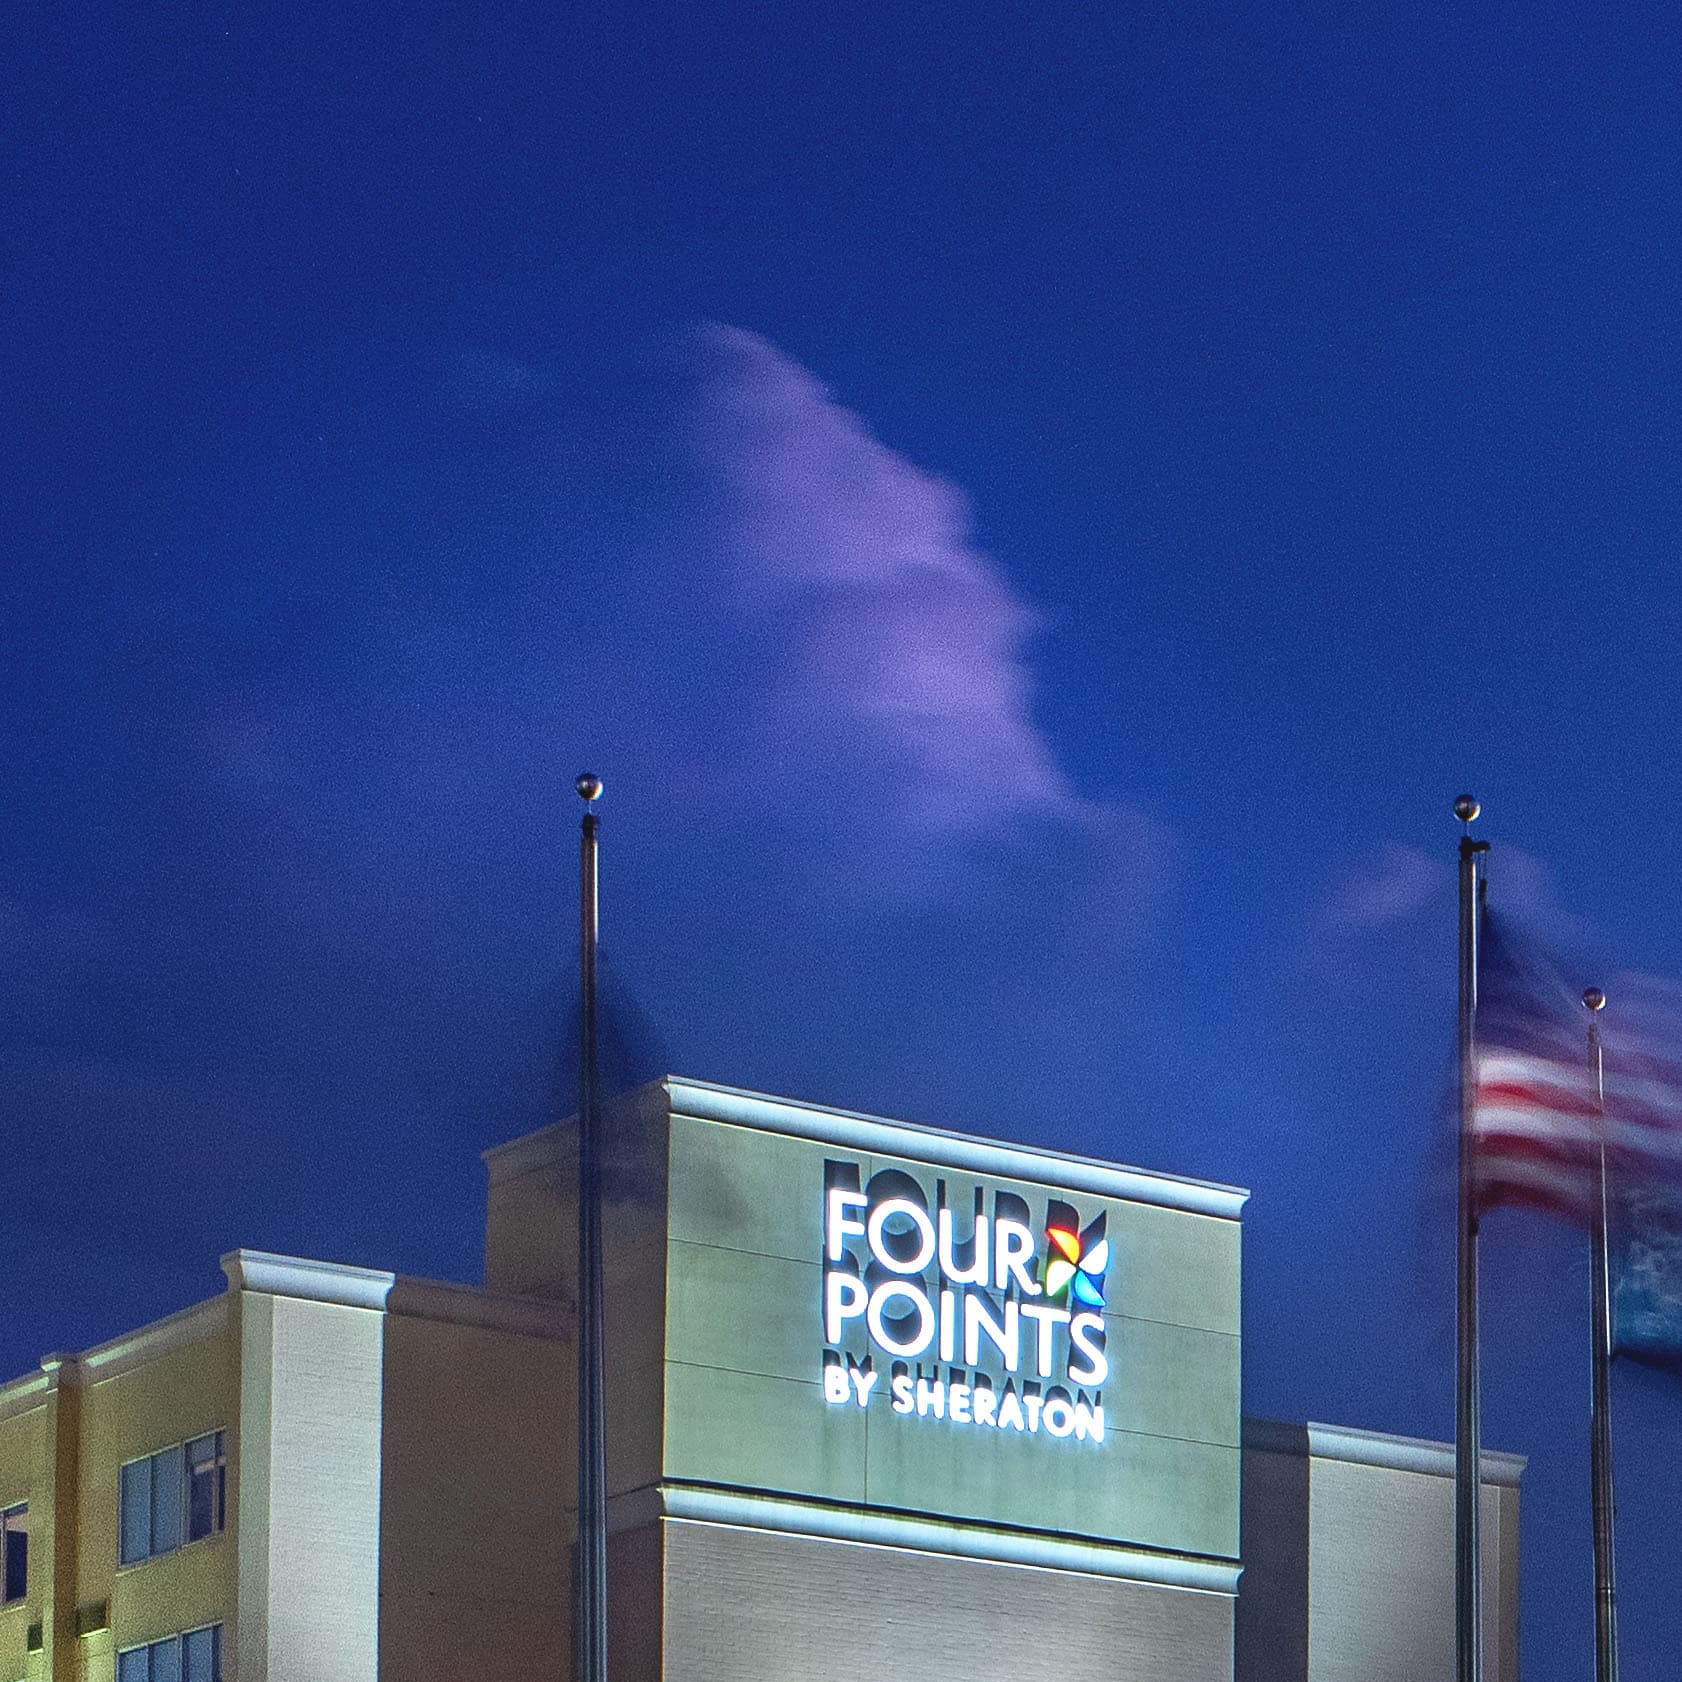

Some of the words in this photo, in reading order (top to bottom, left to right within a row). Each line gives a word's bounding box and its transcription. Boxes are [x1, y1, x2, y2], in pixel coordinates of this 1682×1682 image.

[827, 1187, 1042, 1297] FOUR
[826, 1271, 1109, 1387] POINTS
[824, 1365, 878, 1408] BY
[892, 1375, 1105, 1444] SHERATON
